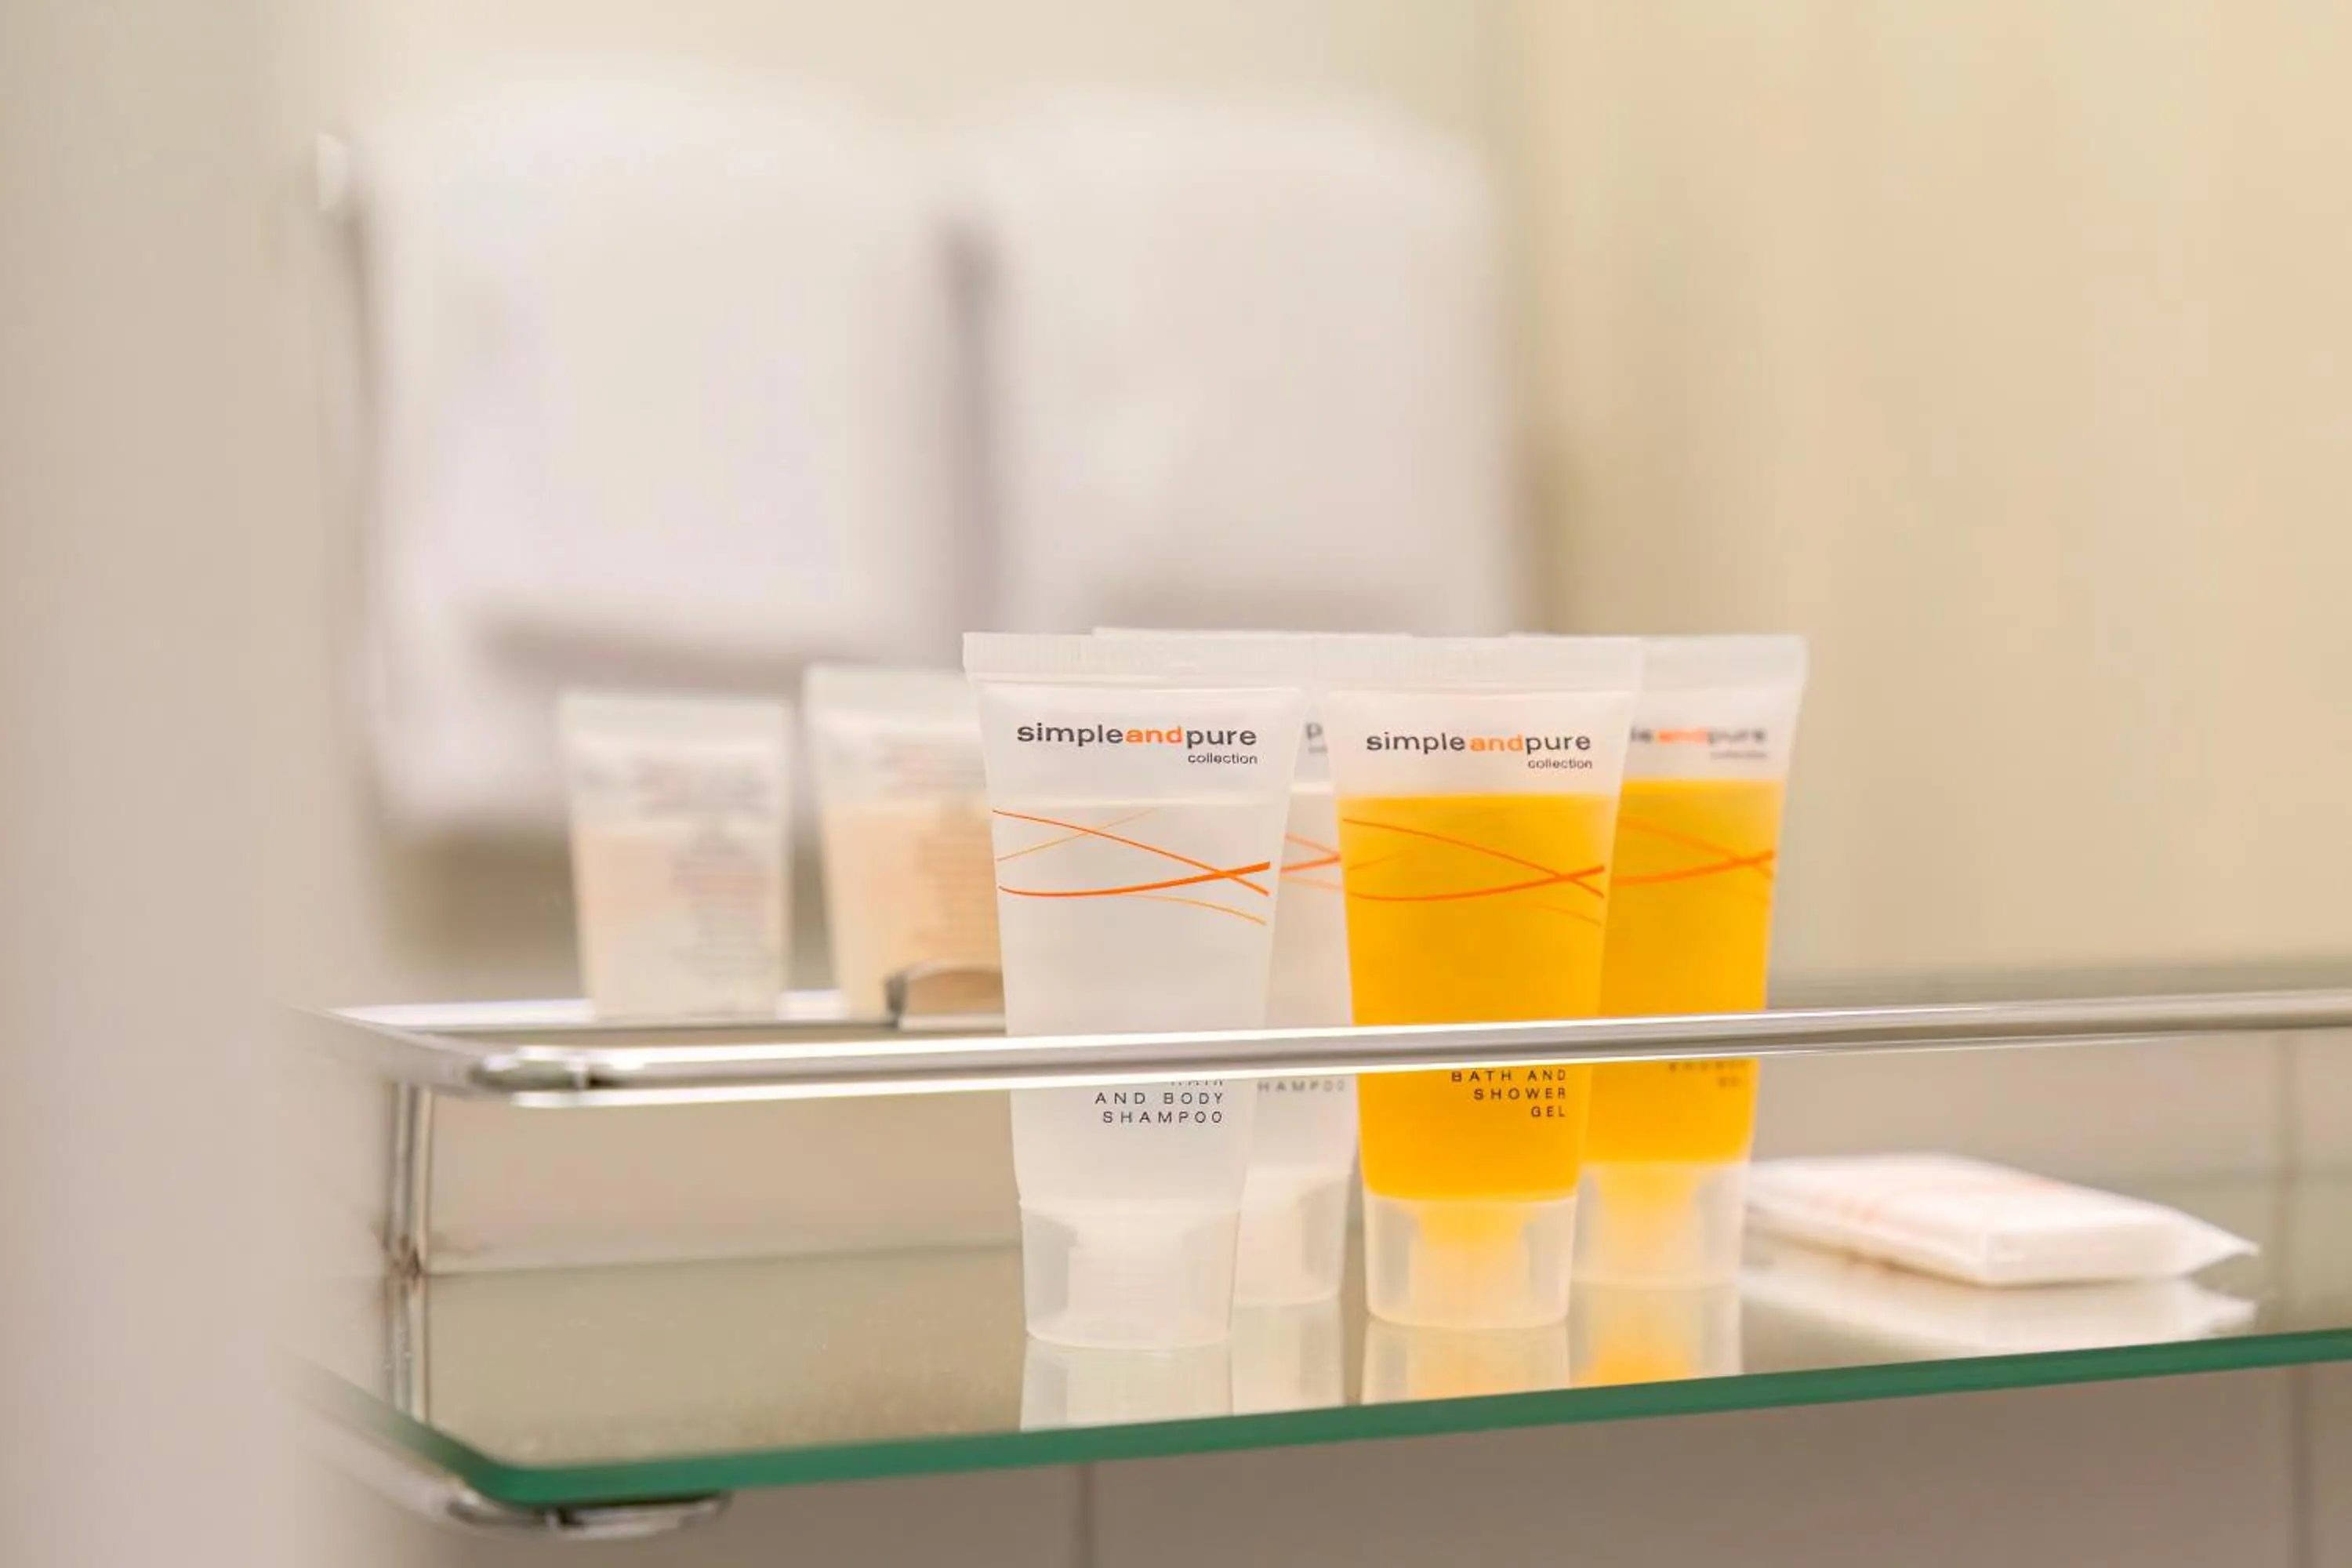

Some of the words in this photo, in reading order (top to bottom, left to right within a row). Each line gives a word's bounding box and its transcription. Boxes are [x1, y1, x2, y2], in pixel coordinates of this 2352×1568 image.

[1016, 722, 1258, 750] simpleandpure
[1366, 731, 1592, 755] simpleandpure
[1188, 753, 1258, 765] collection
[1528, 758, 1593, 770] collection
[1451, 1069, 1512, 1083] BATH
[1526, 1069, 1566, 1082] AND
[1256, 1079, 1346, 1093] HAMPOO
[1094, 1091, 1146, 1105] AND
[1163, 1091, 1224, 1105] BODY
[1474, 1087, 1566, 1101] SHOWER
[1102, 1110, 1223, 1123] SHAMPOO
[1530, 1105, 1566, 1118] GEL
